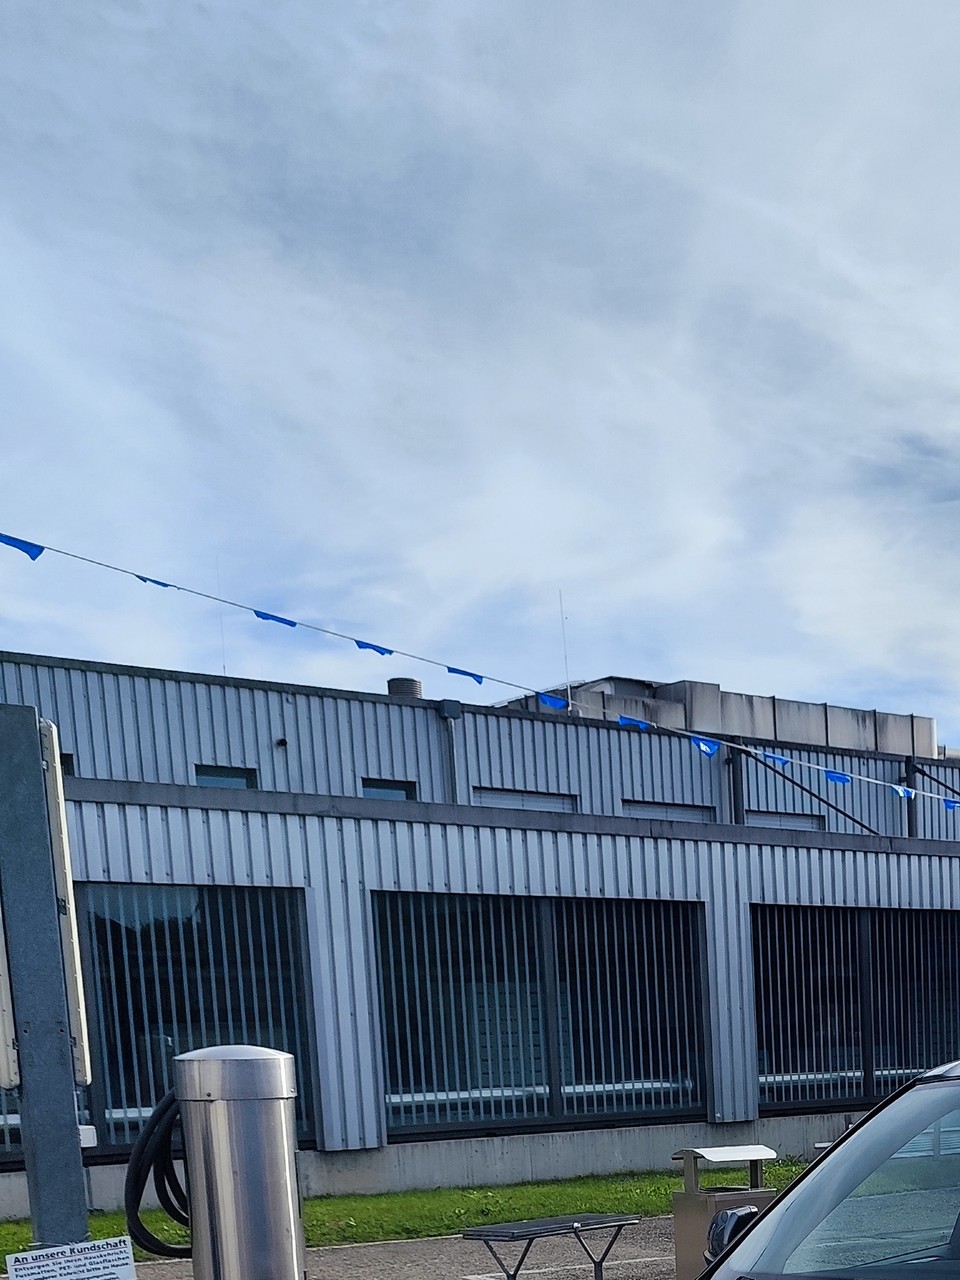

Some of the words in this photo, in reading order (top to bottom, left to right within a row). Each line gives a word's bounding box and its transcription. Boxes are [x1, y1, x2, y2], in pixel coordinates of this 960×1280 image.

[13, 1256, 28, 1264] An
[32, 1250, 66, 1261] unsere
[70, 1239, 127, 1255] Kundschaft
